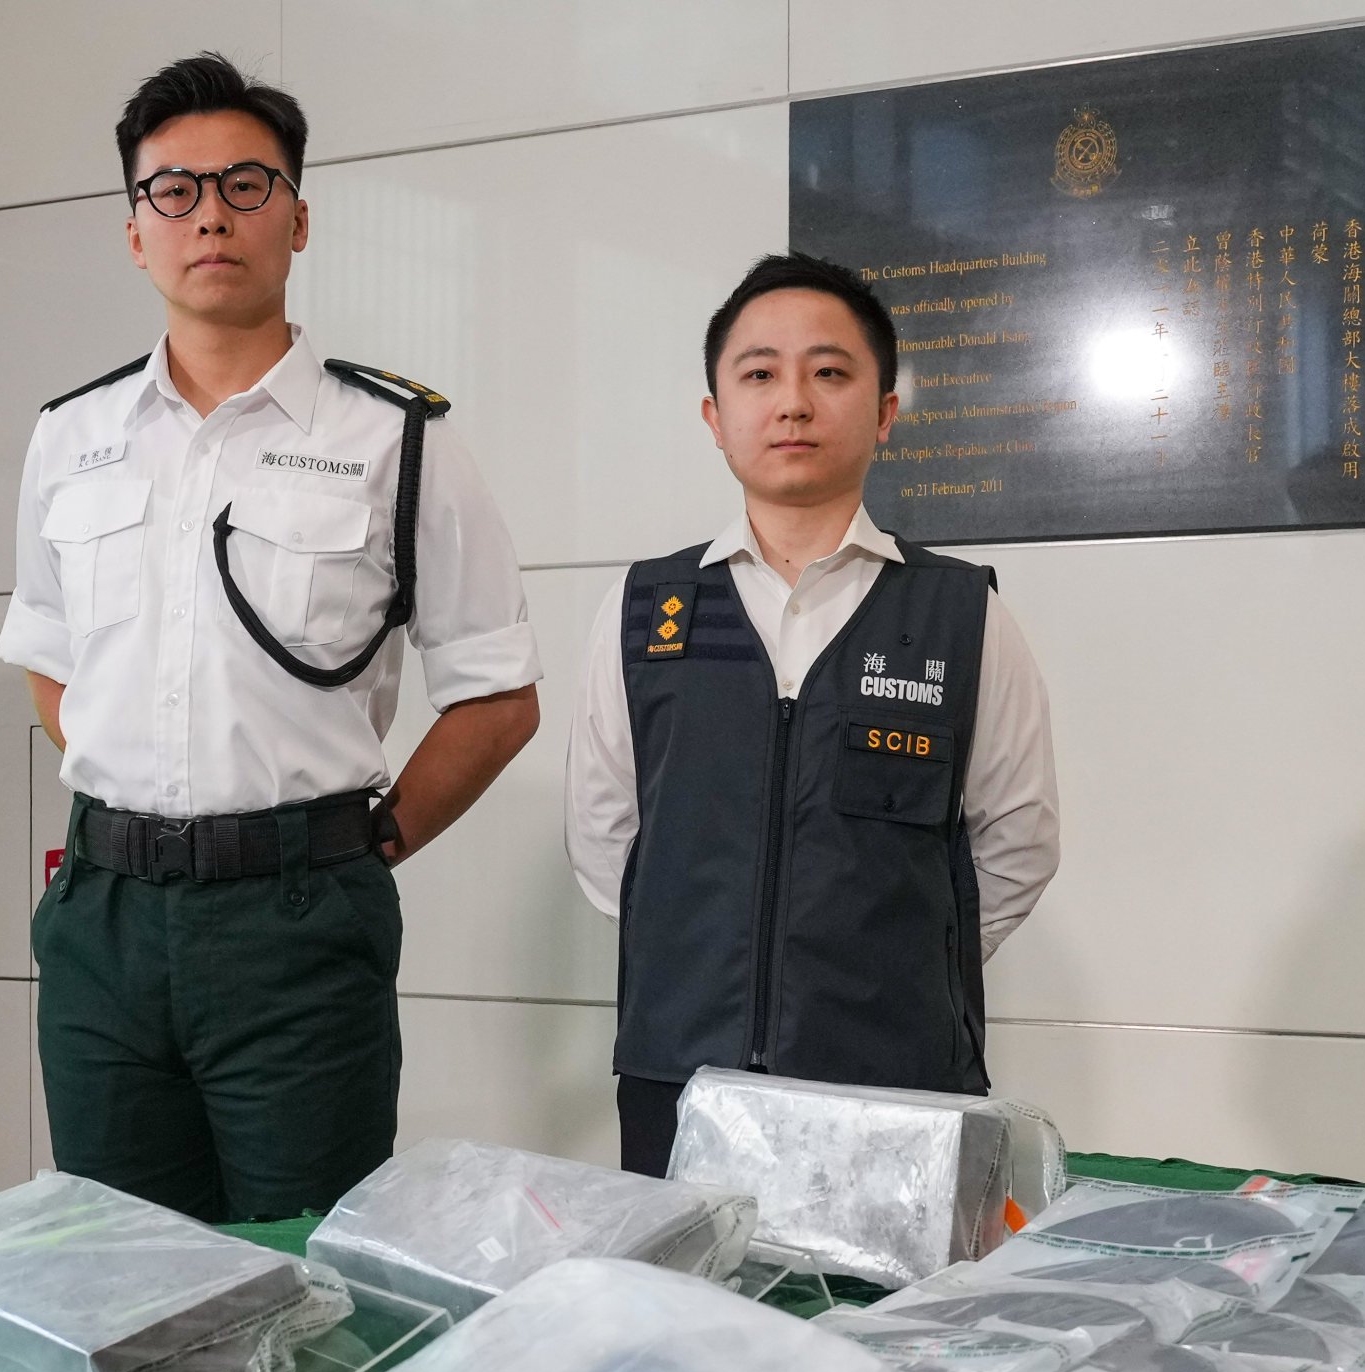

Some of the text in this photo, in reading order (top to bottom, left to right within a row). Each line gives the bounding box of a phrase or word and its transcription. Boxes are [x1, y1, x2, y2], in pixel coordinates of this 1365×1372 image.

[1310, 221, 1330, 264] 荷蒙
[860, 251, 1047, 281] The Customs Headquarters Building
[890, 292, 1014, 315] was officially opened by
[1278, 224, 1298, 376] 中華人民共和國
[896, 333, 956, 353] Honourable
[959, 330, 996, 347] Donald
[912, 371, 992, 388] Chief Executive
[893, 410, 919, 425] Kong
[921, 405, 957, 425] Special
[961, 402, 1036, 418] Administrative
[882, 448, 896, 462] the
[900, 445, 942, 463] People's
[945, 442, 988, 458] Republic
[901, 480, 1003, 498] on 21 February 2011
[860, 675, 944, 706] CUSTOMS
[868, 729, 931, 755] SCIB
